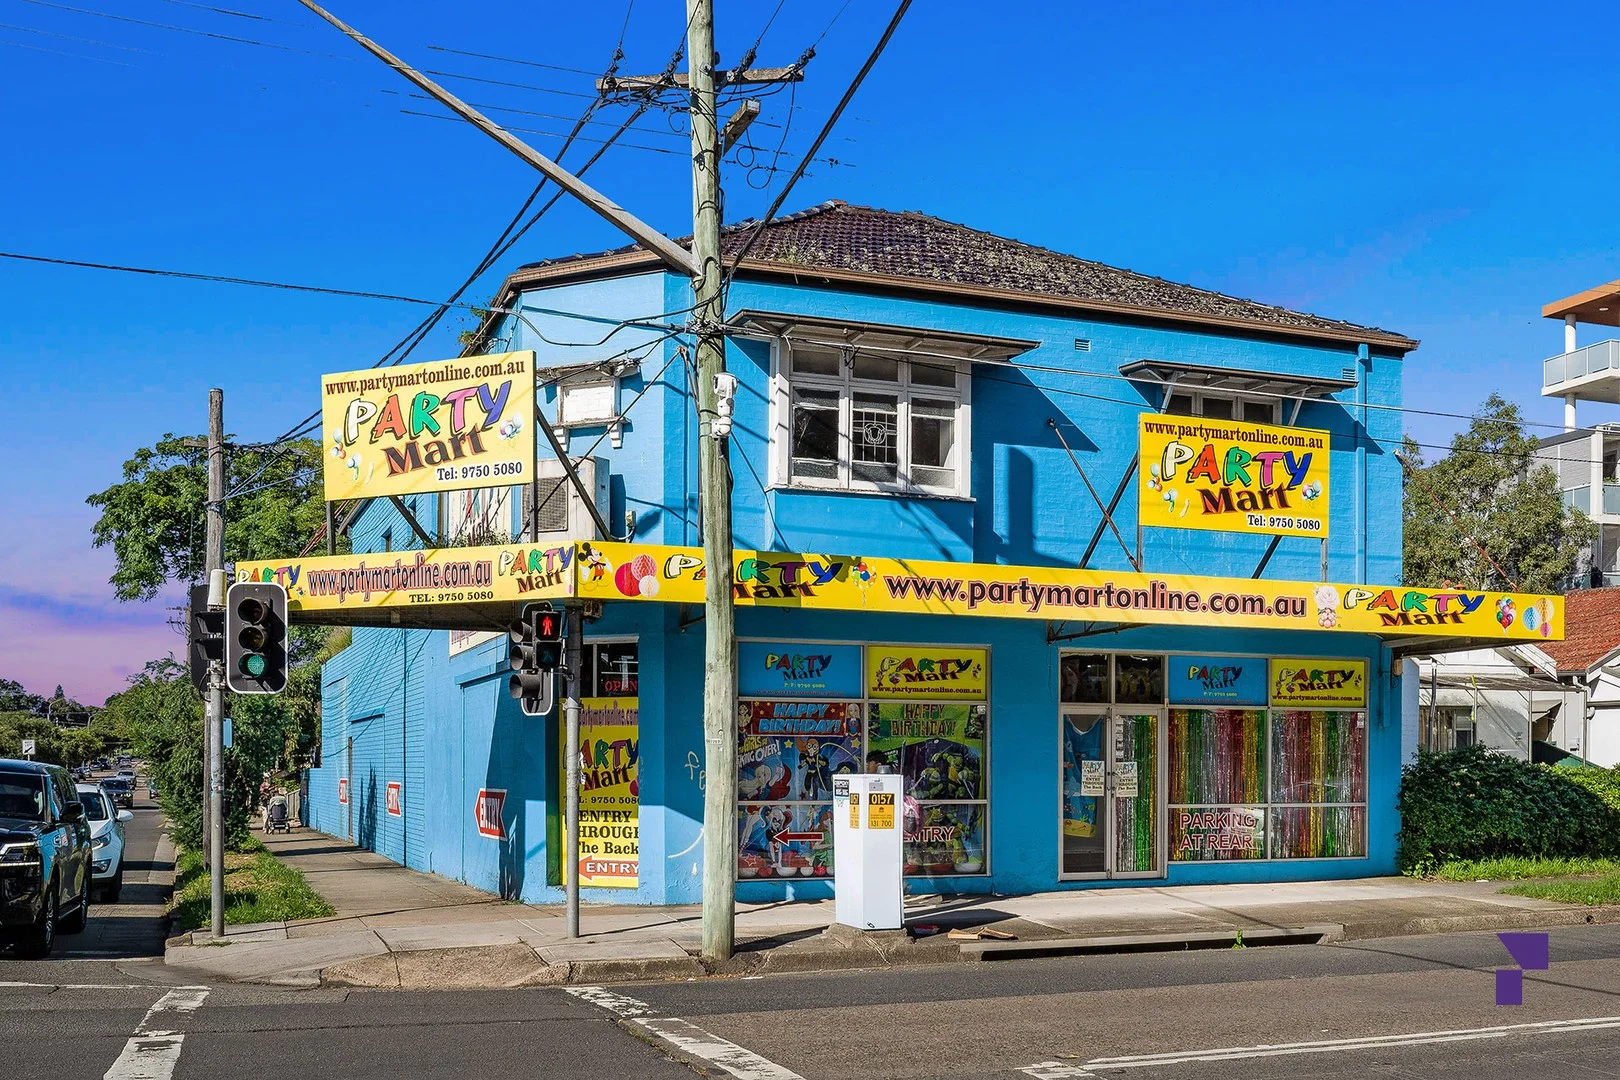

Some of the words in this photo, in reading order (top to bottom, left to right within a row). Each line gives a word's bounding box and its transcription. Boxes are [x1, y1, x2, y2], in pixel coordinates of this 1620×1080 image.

[325, 360, 526, 396] www.partymartonline.com.au
[344, 379, 513, 447] PARTY
[1144, 422, 1324, 449] www.partymartonline.com.au
[380, 423, 488, 478] Mart
[437, 467, 458, 481] Tel:
[461, 464, 490, 479] 9750
[494, 461, 523, 476] 5080
[1160, 440, 1313, 491] PARTY
[1196, 482, 1292, 516] Mart
[1247, 514, 1267, 527] Tel:
[1269, 516, 1294, 530] 9750
[1296, 518, 1321, 531] 5080
[498, 546, 574, 576] PARTY
[664, 553, 844, 586] PRTY
[237, 564, 301, 587] PARTY
[306, 552, 493, 604] www.partymartonline.com.au
[515, 569, 564, 594] Mart
[409, 594, 435, 603] TEL:
[438, 592, 464, 602] 9750
[467, 590, 494, 600] 5080
[883, 574, 1308, 618] www.partymartonline.com.au
[1343, 587, 1486, 615] PARTY
[1377, 609, 1465, 627] Mart
[765, 652, 833, 672] PARTY
[880, 656, 973, 673] PARTY
[782, 668, 822, 681] Mart
[903, 670, 960, 682] Mart
[1188, 665, 1243, 682] PARTY
[1279, 668, 1355, 683] PARTY
[872, 686, 982, 694] www.partymartonline.com.au
[1201, 679, 1235, 690] Mart
[1297, 680, 1343, 691] Mart
[1272, 694, 1362, 702] www.partymartonline.com.au
[773, 702, 830, 718] HAPPY
[903, 703, 946, 719] HAPPY
[758, 718, 841, 734] BIRTHDAY!
[891, 720, 957, 736] BIRTHDAY!
[590, 796, 616, 804] 9750
[618, 796, 638, 804] 508
[871, 794, 892, 804] 0157
[479, 797, 500, 830] ENTRY
[580, 810, 632, 823] ENTRY
[1179, 812, 1256, 830] PARKING
[603, 842, 638, 855] Back
[1179, 834, 1207, 850] AT
[1208, 834, 1253, 850] REAR
[585, 862, 638, 874] ENTRY
